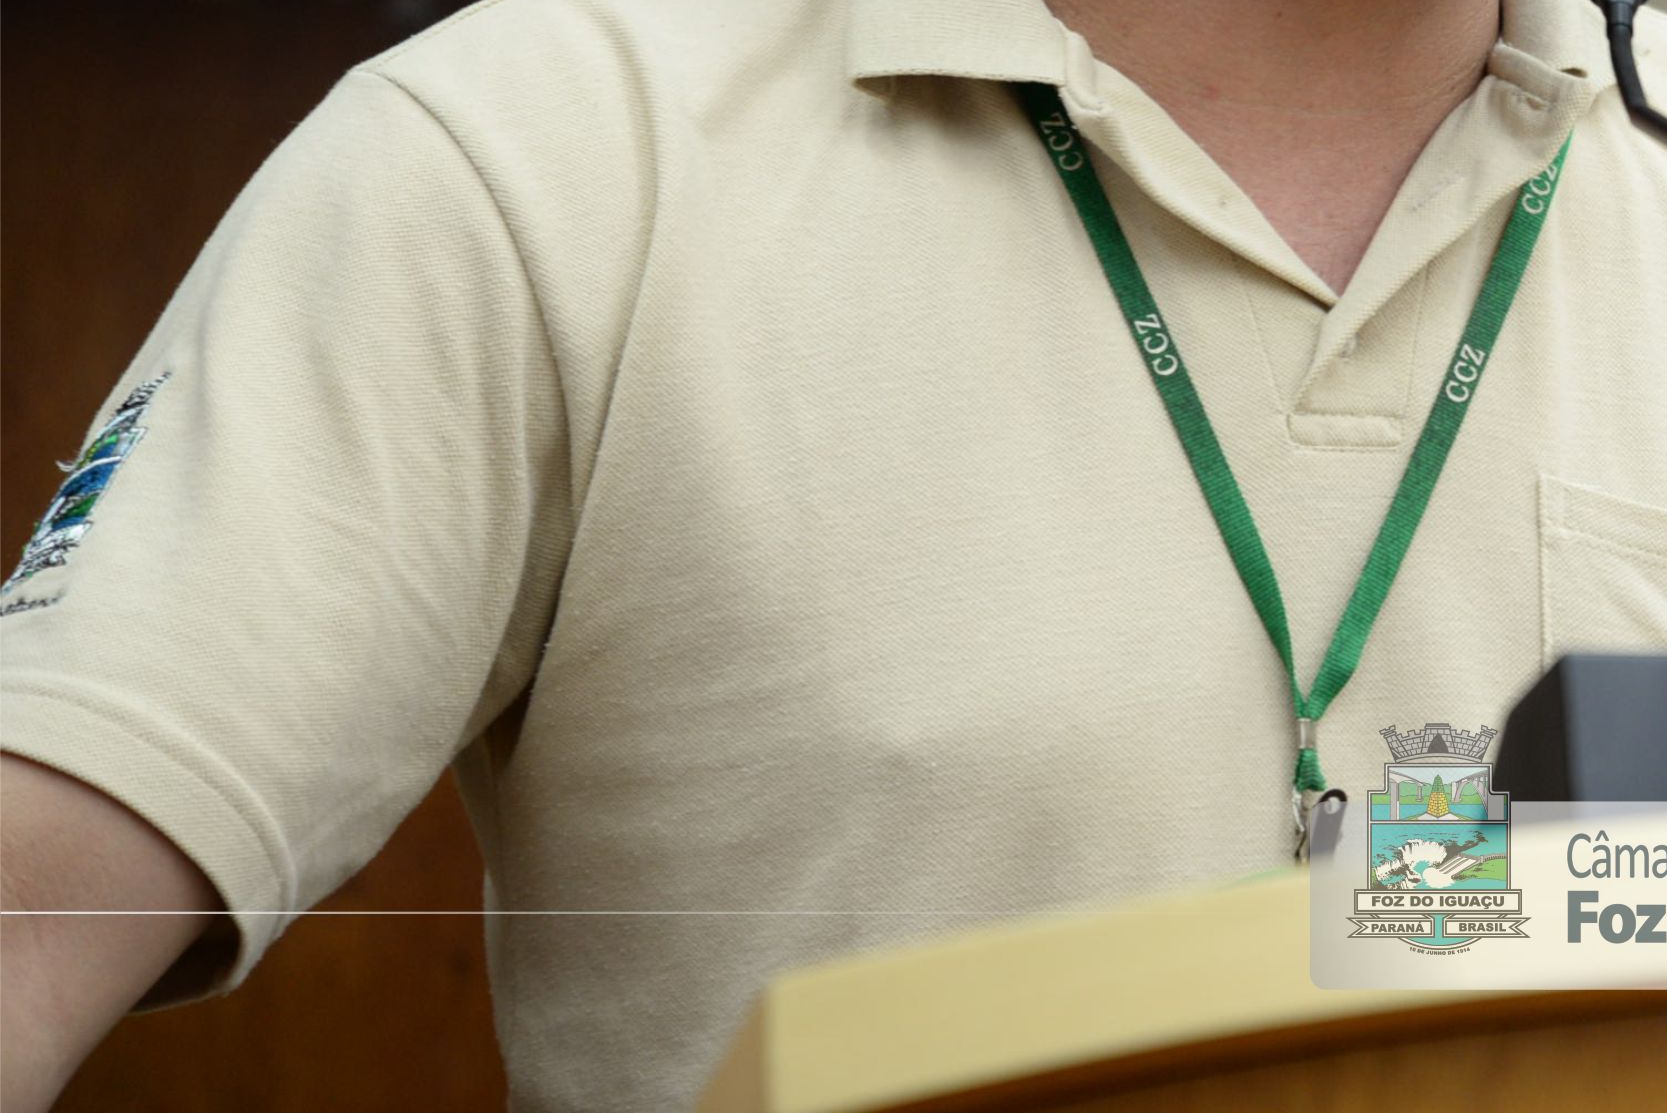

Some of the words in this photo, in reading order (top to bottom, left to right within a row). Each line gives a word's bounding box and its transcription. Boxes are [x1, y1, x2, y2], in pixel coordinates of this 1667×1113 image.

[1041, 112, 1083, 171] CCZ
[1522, 163, 1558, 214] CCZ
[1134, 314, 1178, 377] CCZ
[1445, 343, 1485, 402] CCZ
